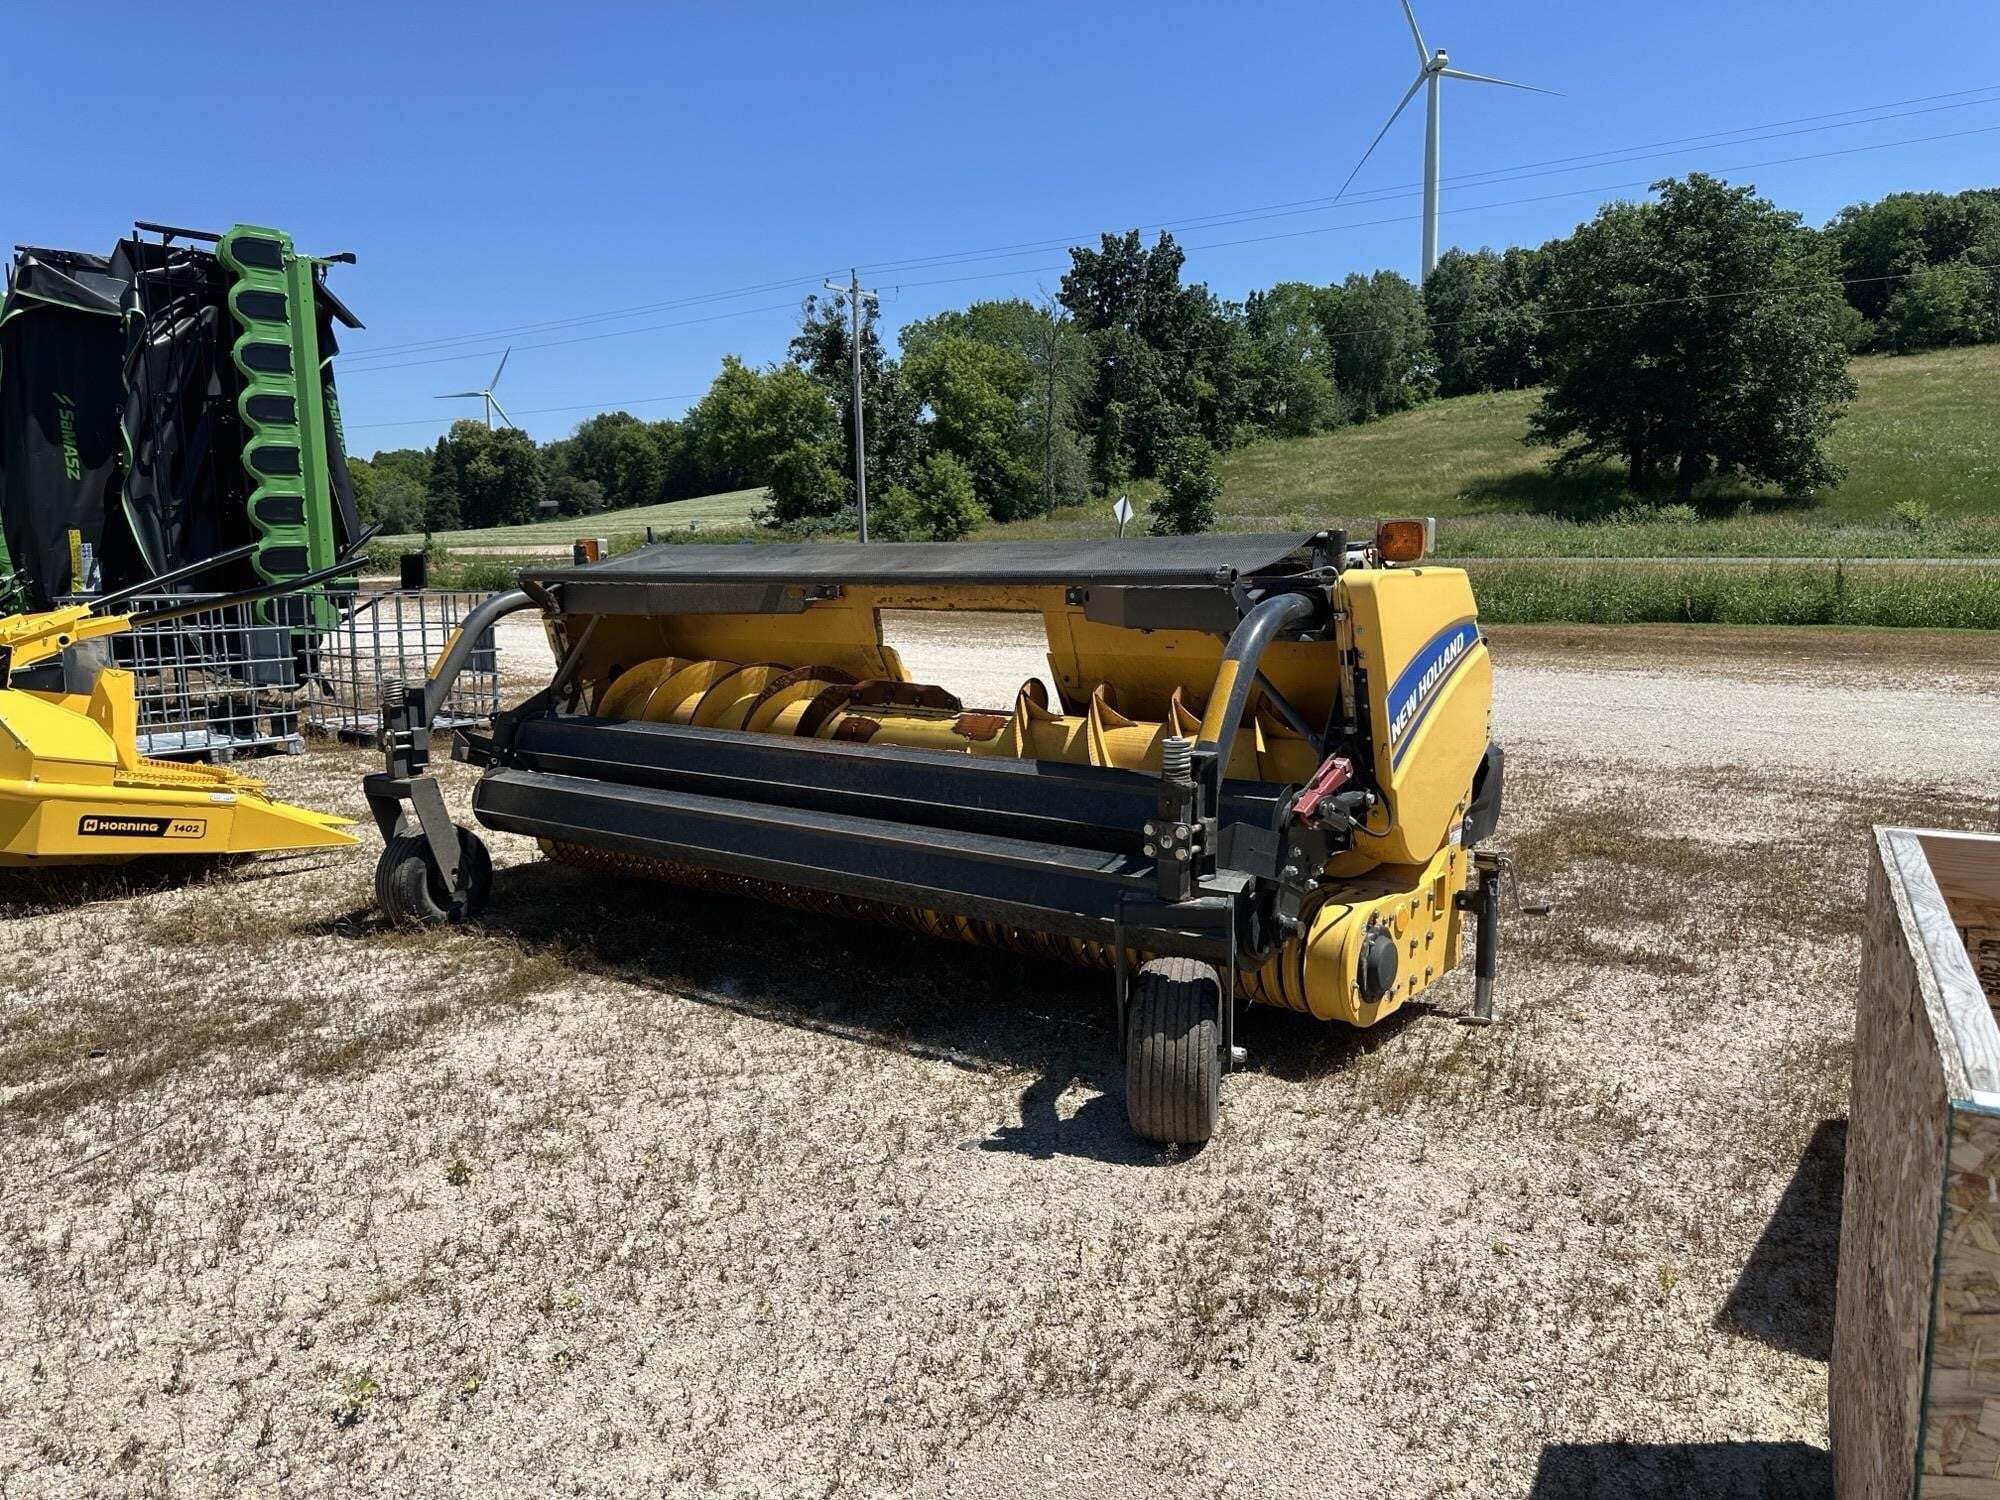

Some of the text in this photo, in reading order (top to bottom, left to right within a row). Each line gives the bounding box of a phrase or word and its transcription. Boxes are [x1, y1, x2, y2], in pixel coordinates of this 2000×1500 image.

[1391, 632, 1464, 743] NEW HOLLAND
[100, 821, 160, 832] HORNING
[173, 824, 200, 833] 1402
